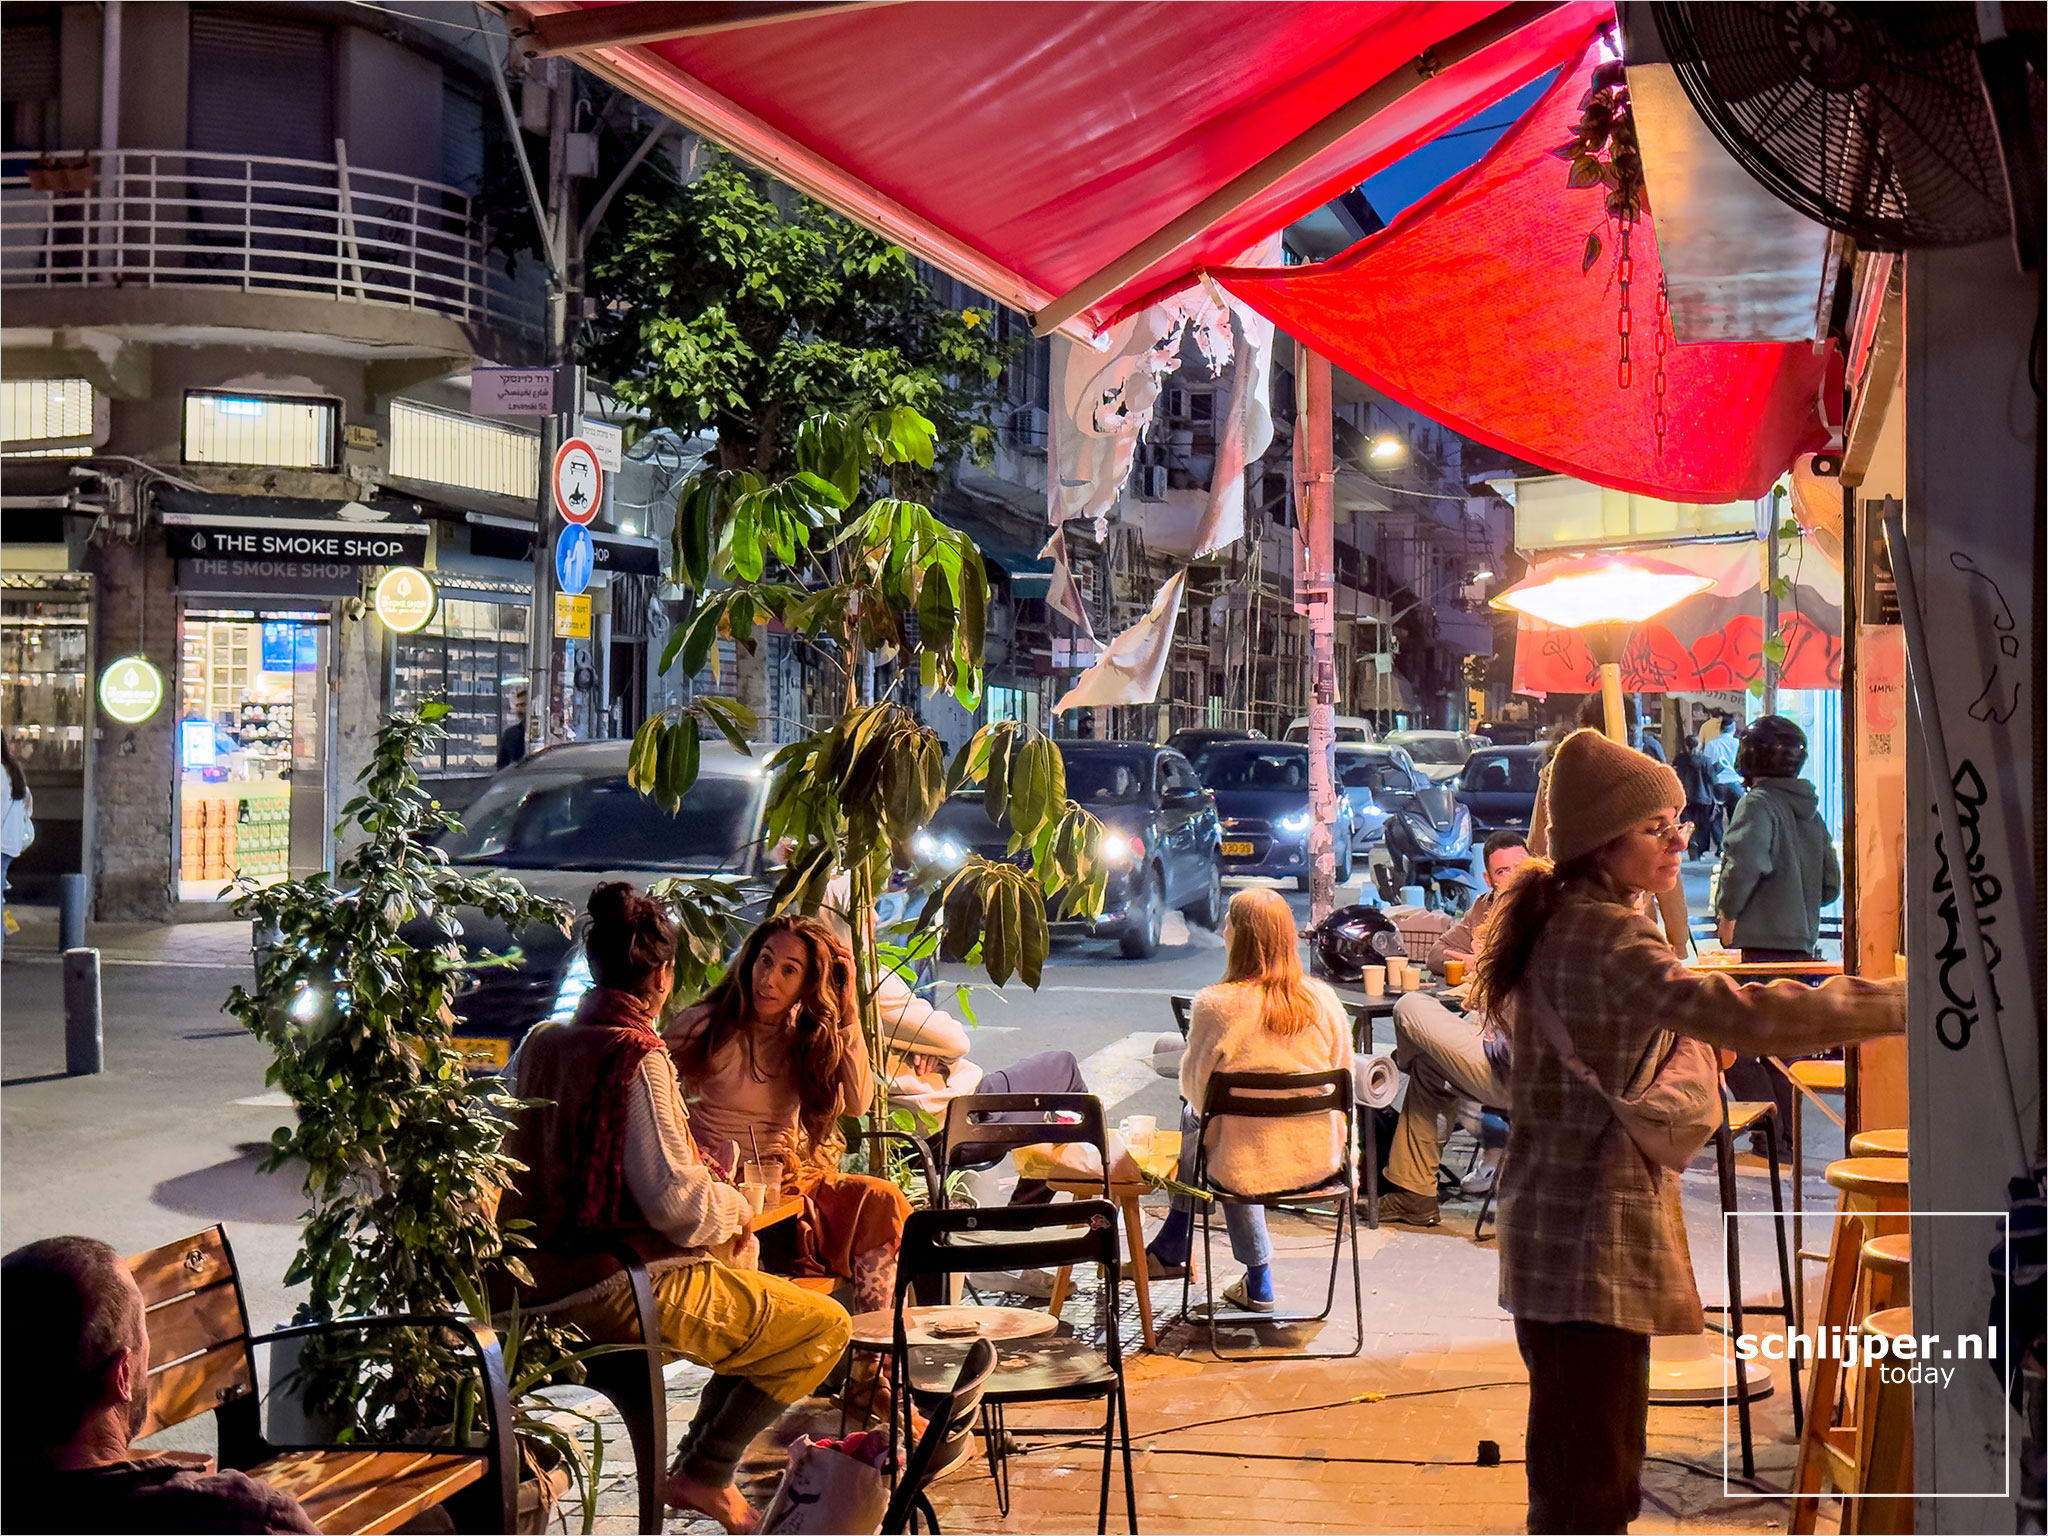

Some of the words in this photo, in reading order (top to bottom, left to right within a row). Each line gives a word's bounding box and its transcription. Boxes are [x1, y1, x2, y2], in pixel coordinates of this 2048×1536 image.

[214, 534, 257, 552] THE
[262, 536, 339, 555] SMOKE
[344, 540, 404, 557] SHOP
[594, 547, 610, 562] HOP
[191, 559, 228, 575] THE
[232, 561, 297, 577] SMOKE
[302, 563, 350, 579] SHOP
